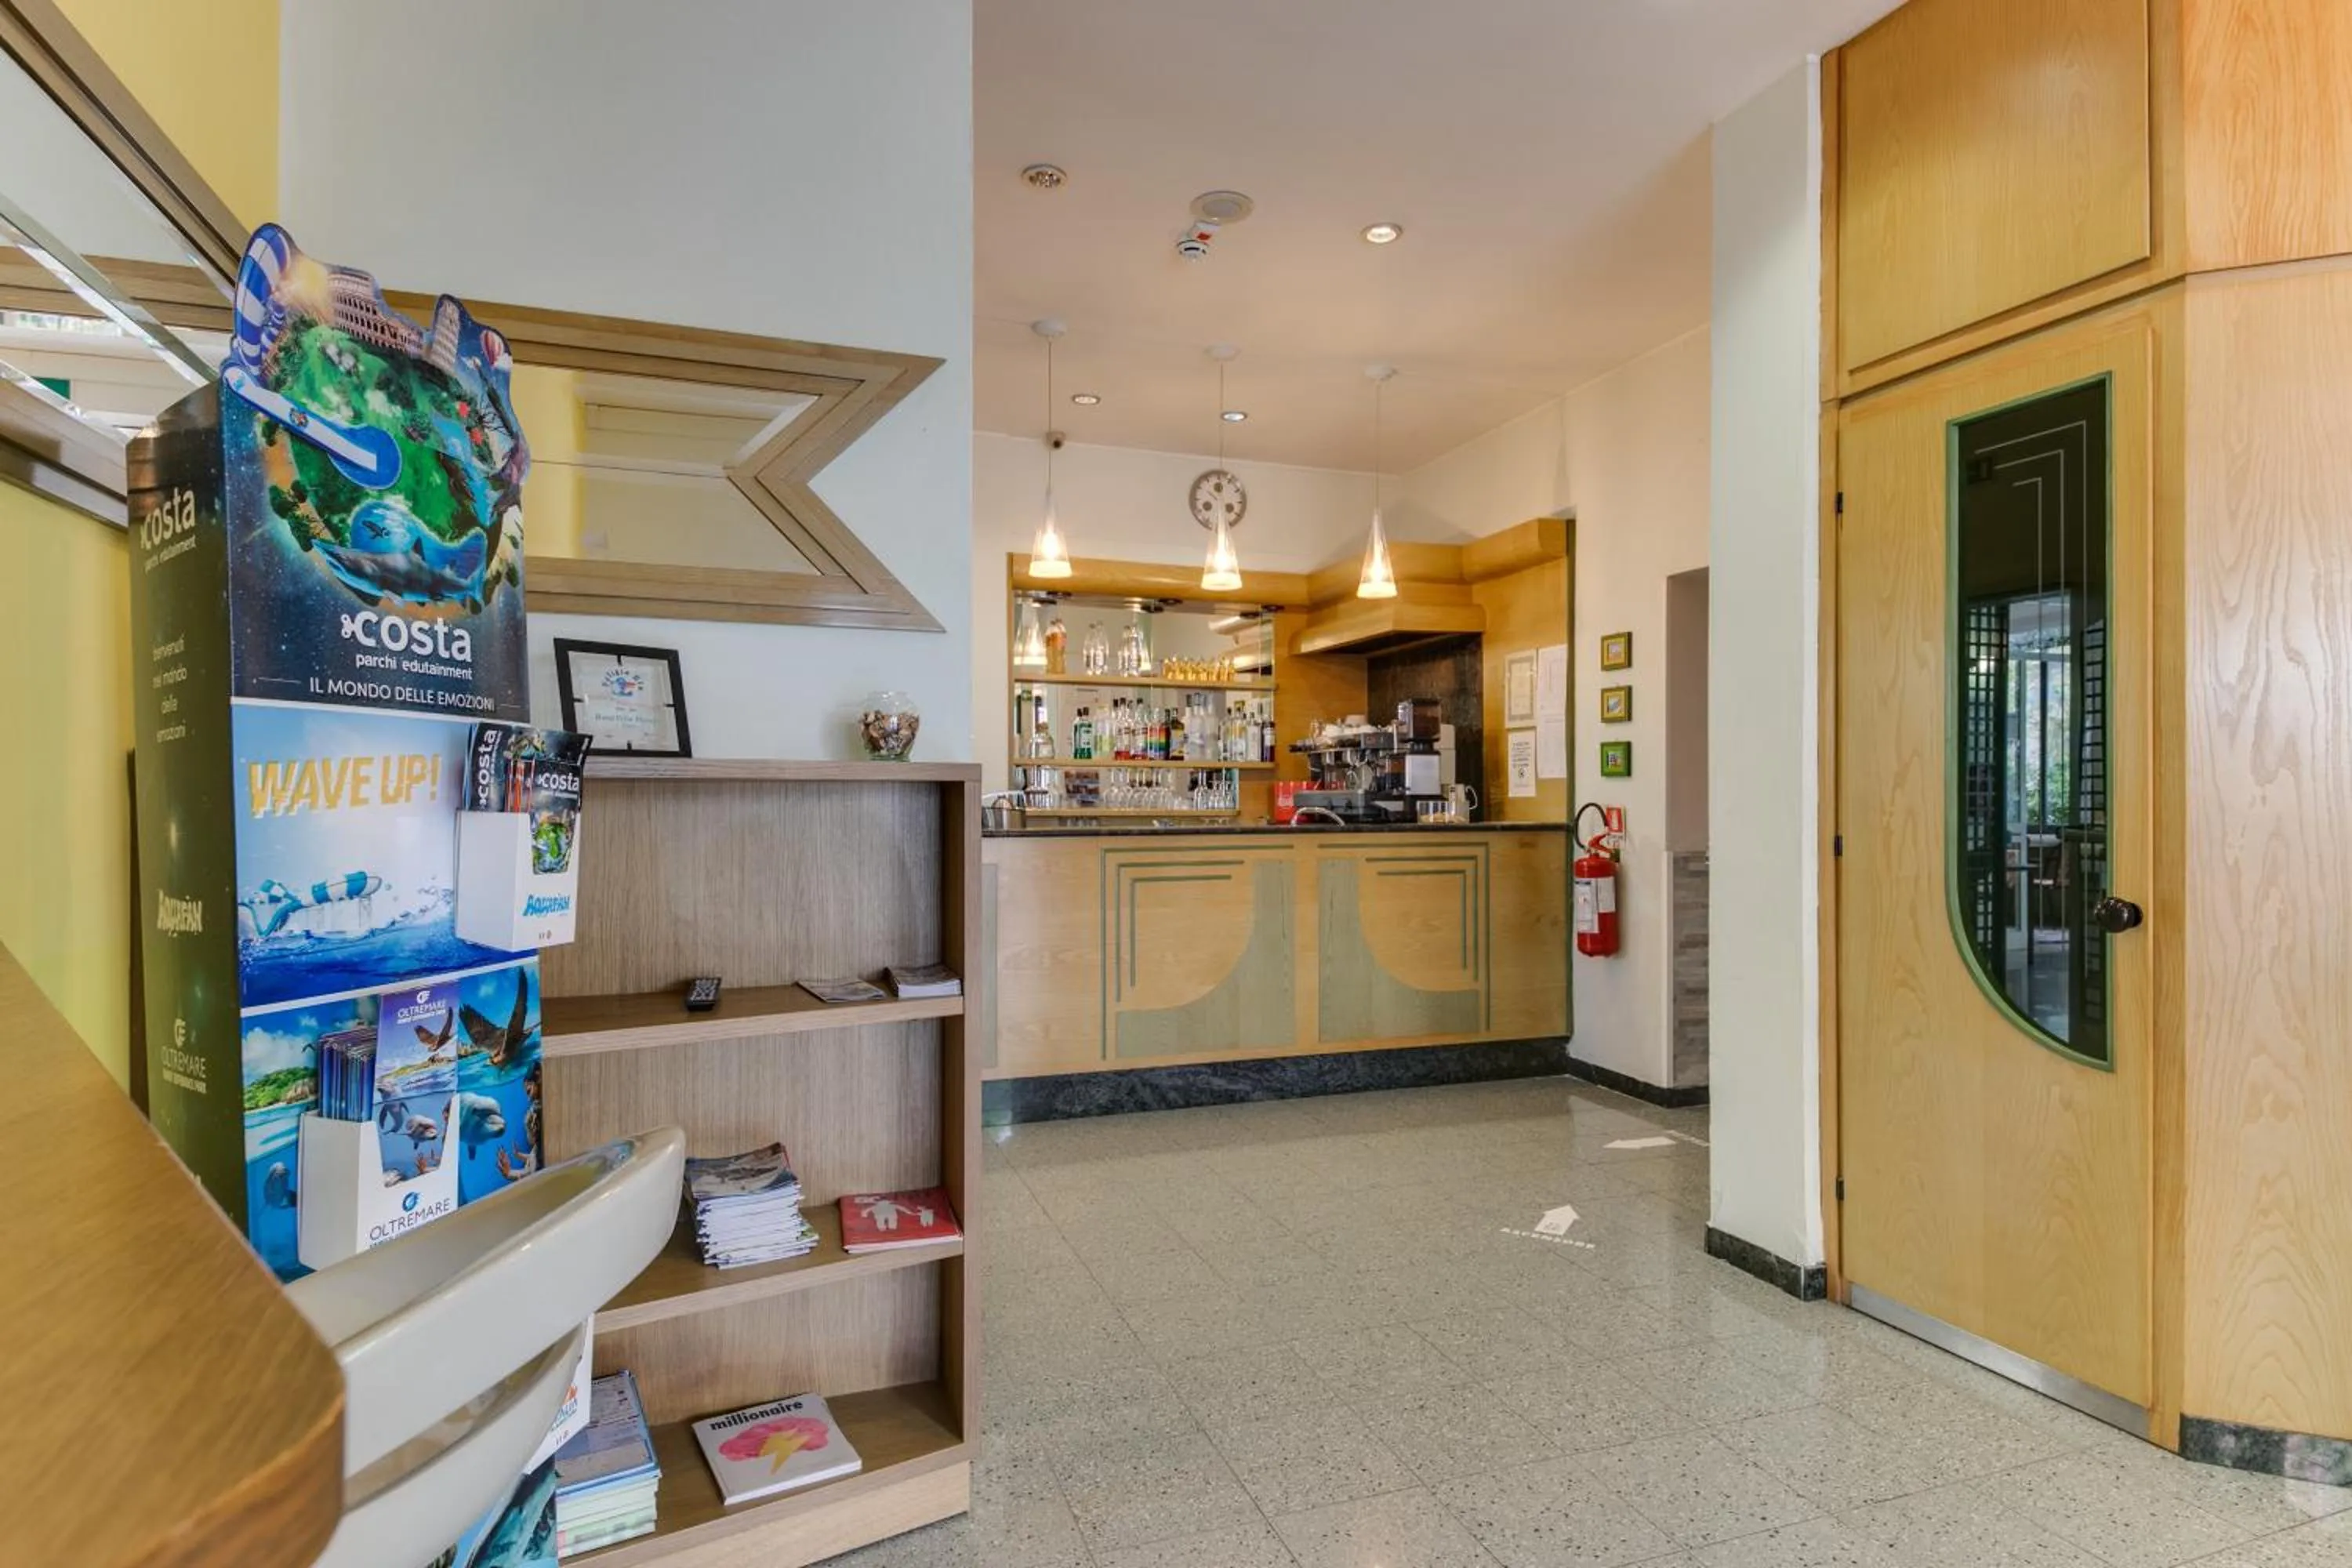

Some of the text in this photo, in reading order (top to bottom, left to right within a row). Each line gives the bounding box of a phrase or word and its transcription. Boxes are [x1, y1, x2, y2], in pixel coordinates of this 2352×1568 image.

[353, 611, 472, 662] costa
[356, 653, 473, 680] parchi edutainment
[310, 677, 495, 712] IL MONDO DELLE EMOZIONI
[477, 729, 498, 797] costa
[542, 772, 579, 791] costa
[249, 757, 375, 818] WAVE
[380, 753, 442, 805] UP!
[369, 1198, 451, 1241] OLTREMARE
[709, 1401, 804, 1431] millionaire
